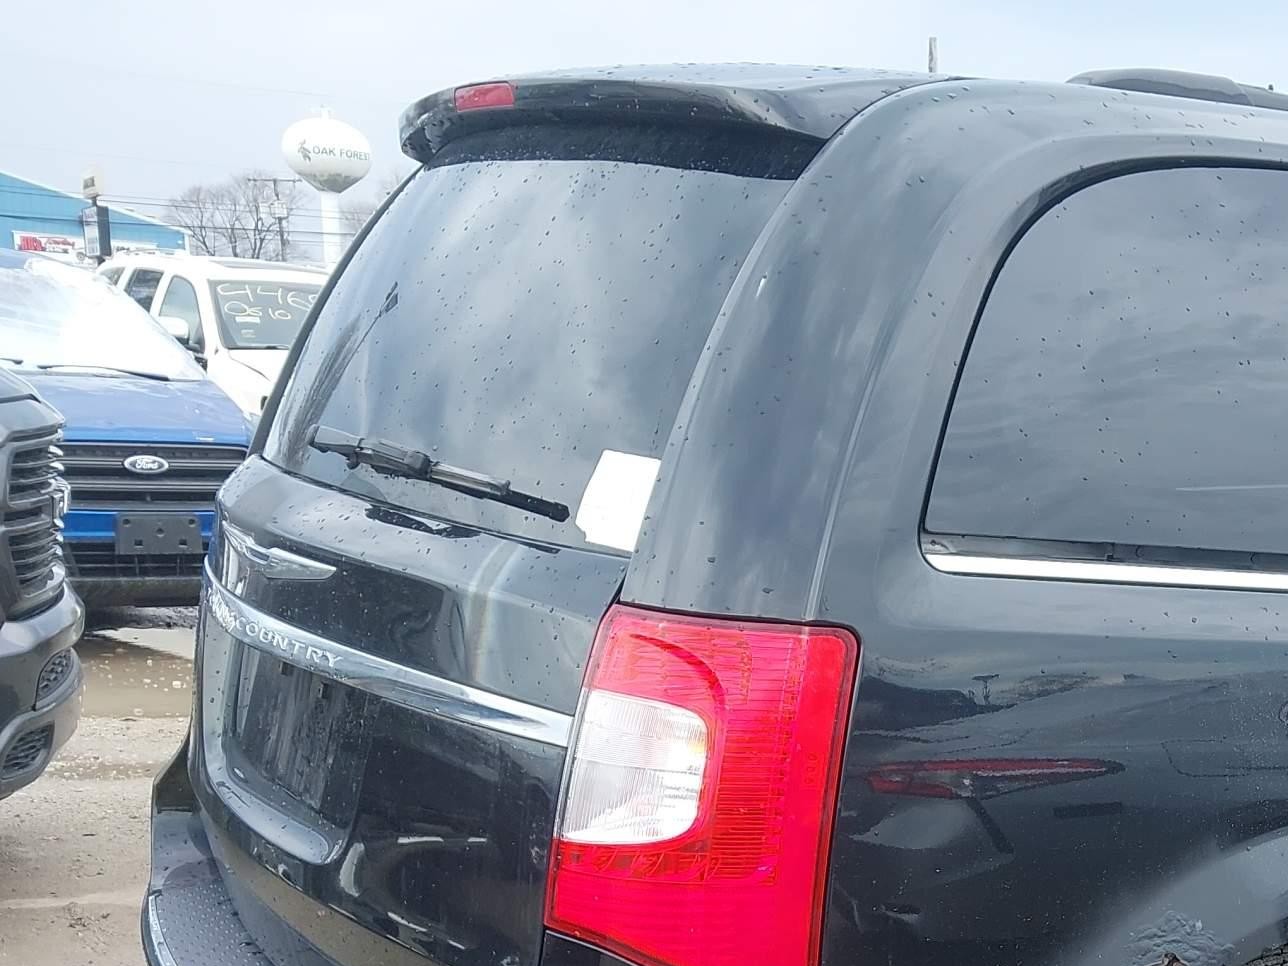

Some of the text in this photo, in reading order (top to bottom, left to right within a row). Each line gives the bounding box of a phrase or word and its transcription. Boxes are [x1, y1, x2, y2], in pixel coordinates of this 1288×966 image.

[313, 145, 336, 157] OAK
[135, 457, 159, 469] Ford
[235, 617, 343, 668] COUNTRY
